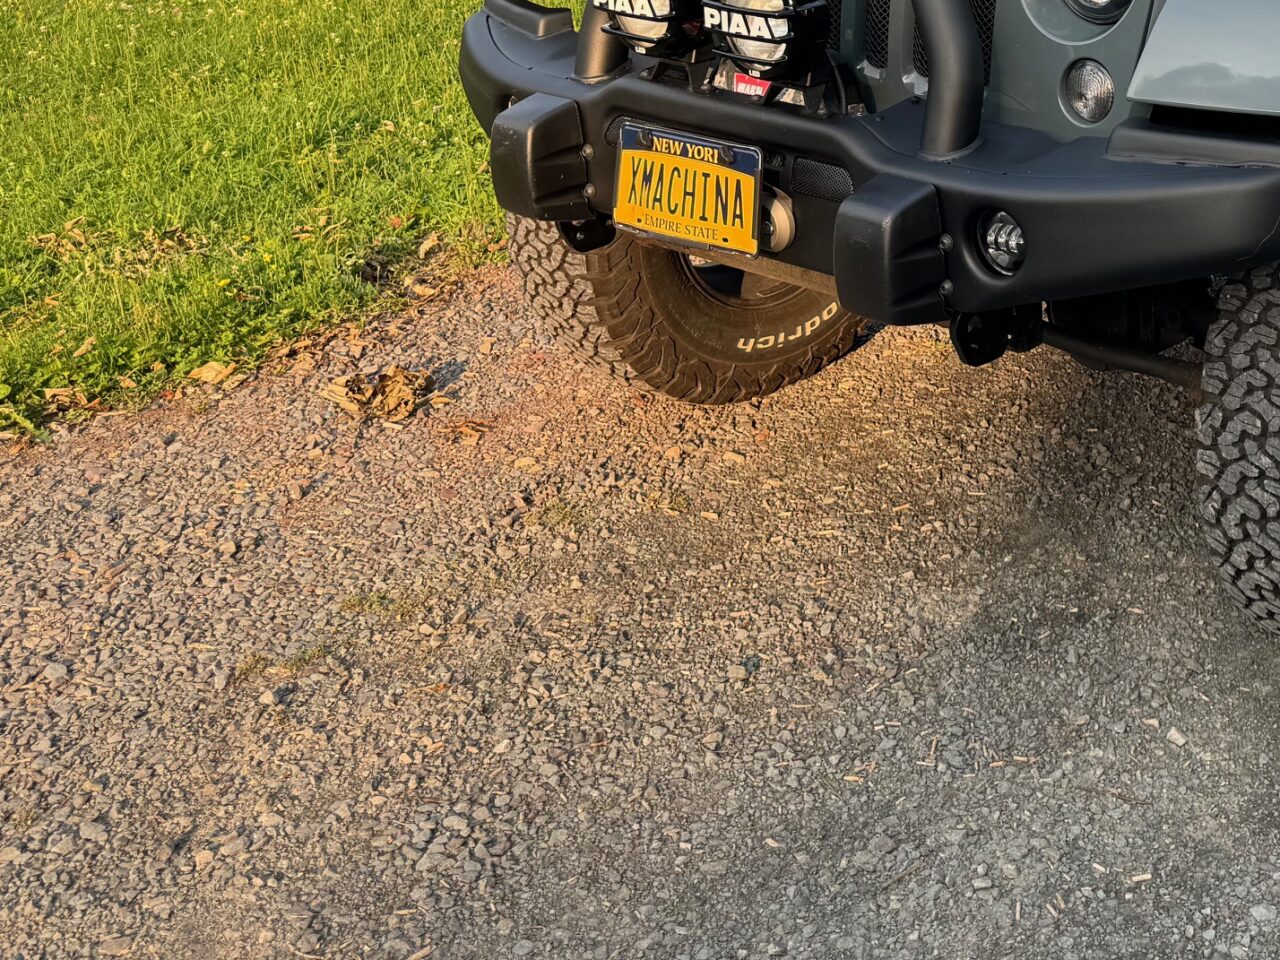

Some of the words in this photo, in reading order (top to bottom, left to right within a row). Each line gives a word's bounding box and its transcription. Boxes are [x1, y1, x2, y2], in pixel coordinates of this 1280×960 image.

[703, 6, 773, 39] PIAA
[652, 135, 683, 157] NEW
[628, 156, 744, 229] XMACHINA
[644, 213, 682, 234] EMPIRE
[684, 224, 719, 241] STATE
